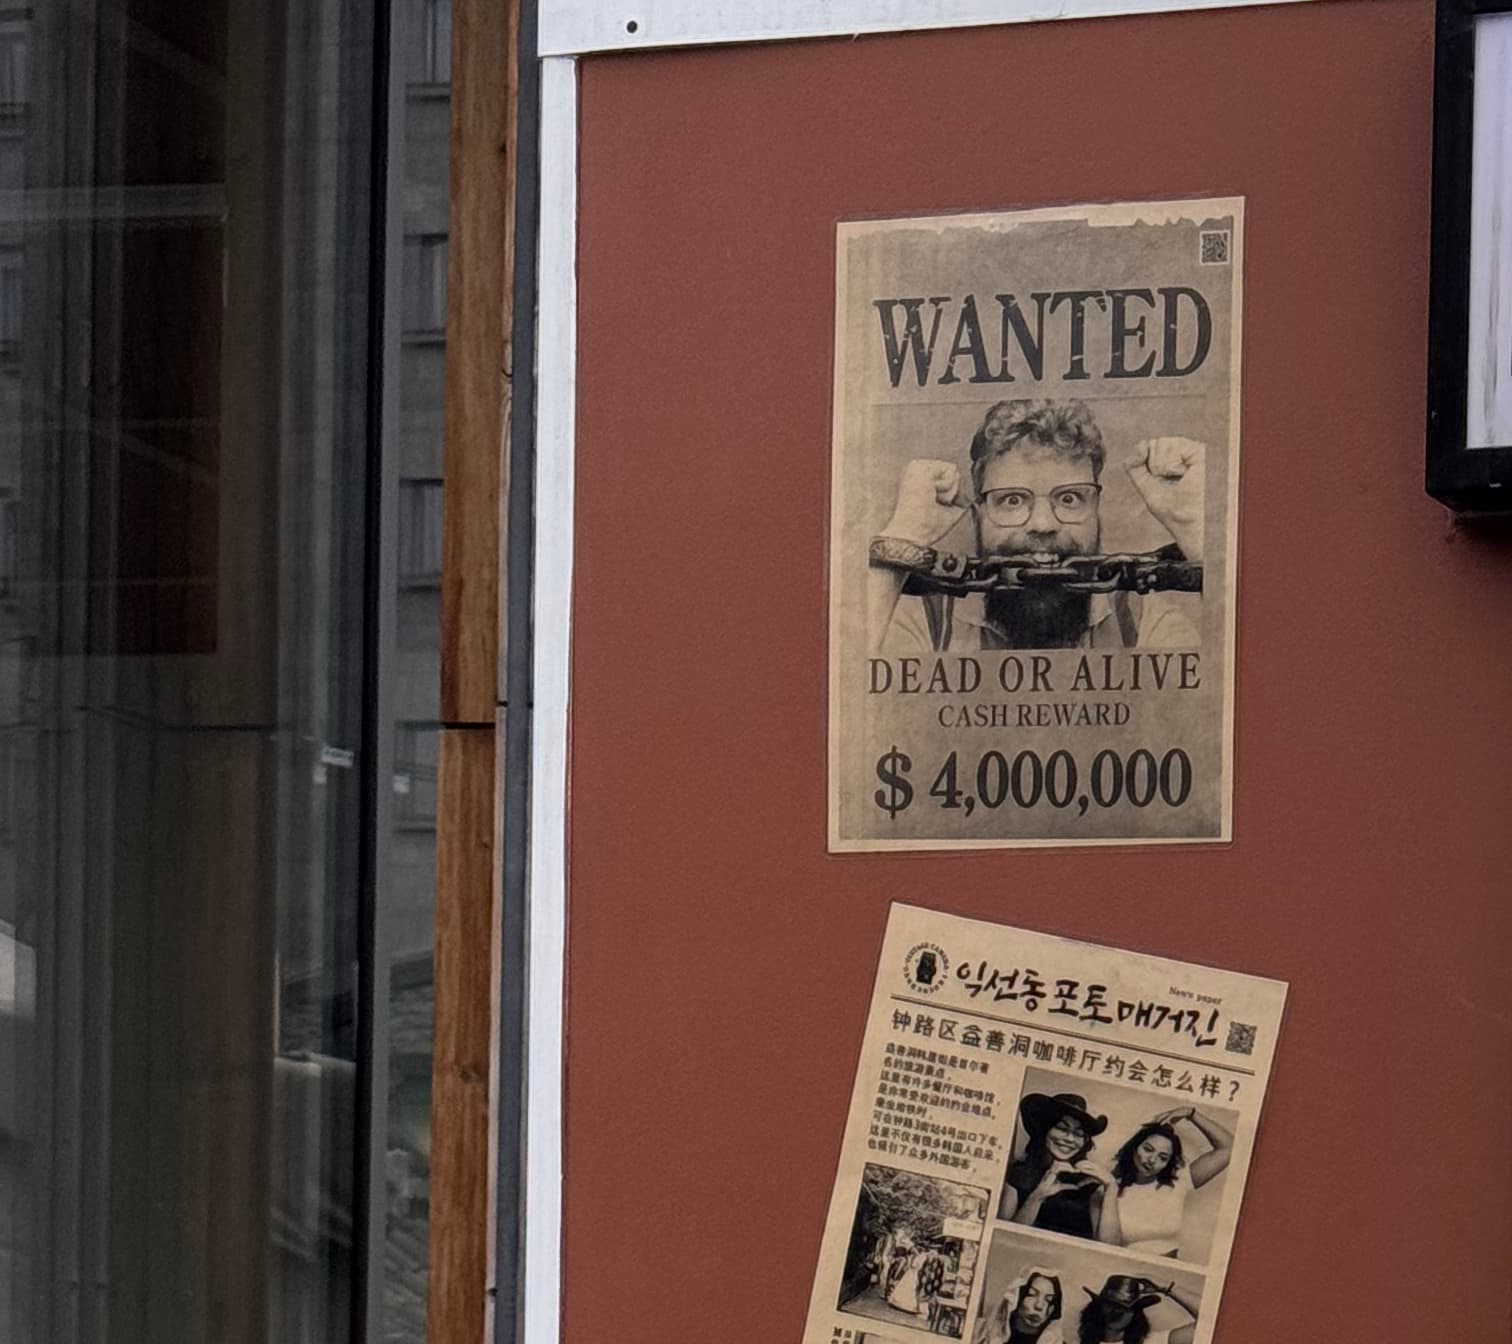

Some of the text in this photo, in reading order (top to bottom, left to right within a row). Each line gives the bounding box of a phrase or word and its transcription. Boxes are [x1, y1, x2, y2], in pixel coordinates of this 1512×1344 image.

[872, 285, 1213, 389] WANTED
[869, 651, 1202, 695] DEAD OR ALIVE
[937, 702, 1130, 727] CASH REWARD
[873, 746, 1192, 819] $ 4,000,000
